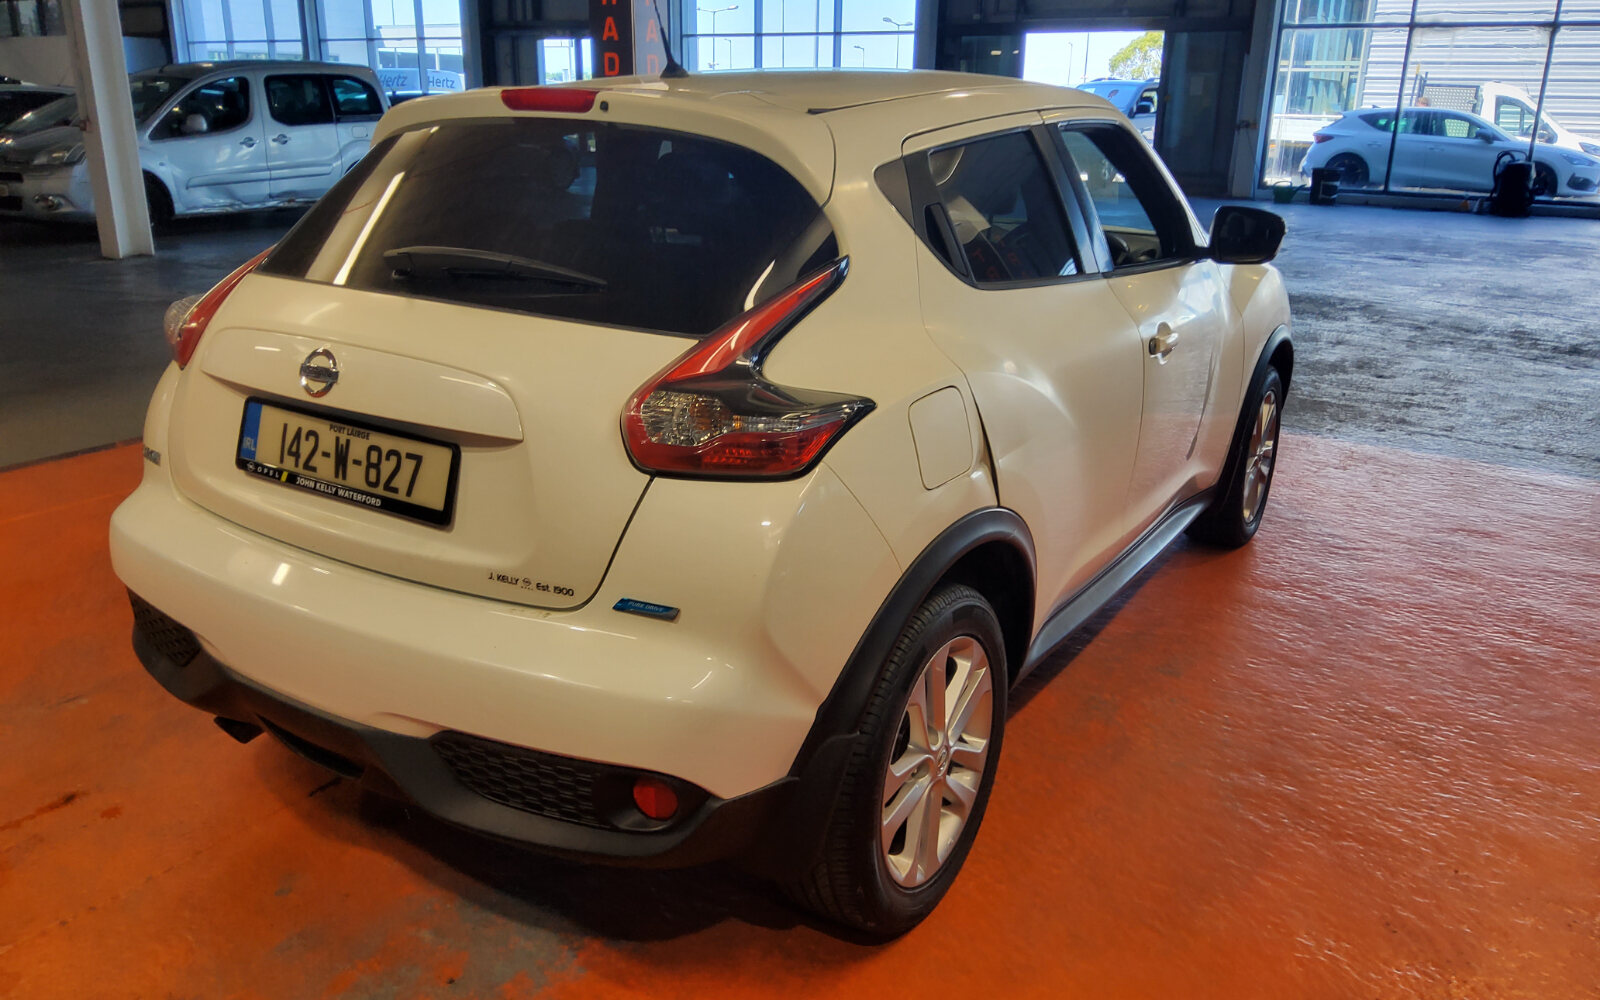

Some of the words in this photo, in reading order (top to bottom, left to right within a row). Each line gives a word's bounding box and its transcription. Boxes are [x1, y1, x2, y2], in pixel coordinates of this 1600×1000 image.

[602, 0, 619, 76] AD
[428, 76, 455, 88] Hertz
[329, 423, 346, 434] PORT
[242, 436, 256, 451] IRL
[279, 422, 424, 498] 142-W-827
[257, 466, 280, 478] OPEL
[295, 476, 315, 489] JOHN
[315, 481, 337, 494] KELLY
[337, 488, 382, 507] WATERFORD
[488, 572, 495, 581] J.
[496, 573, 519, 585] KELLY
[536, 582, 551, 592] Est.
[553, 585, 575, 597] 1900
